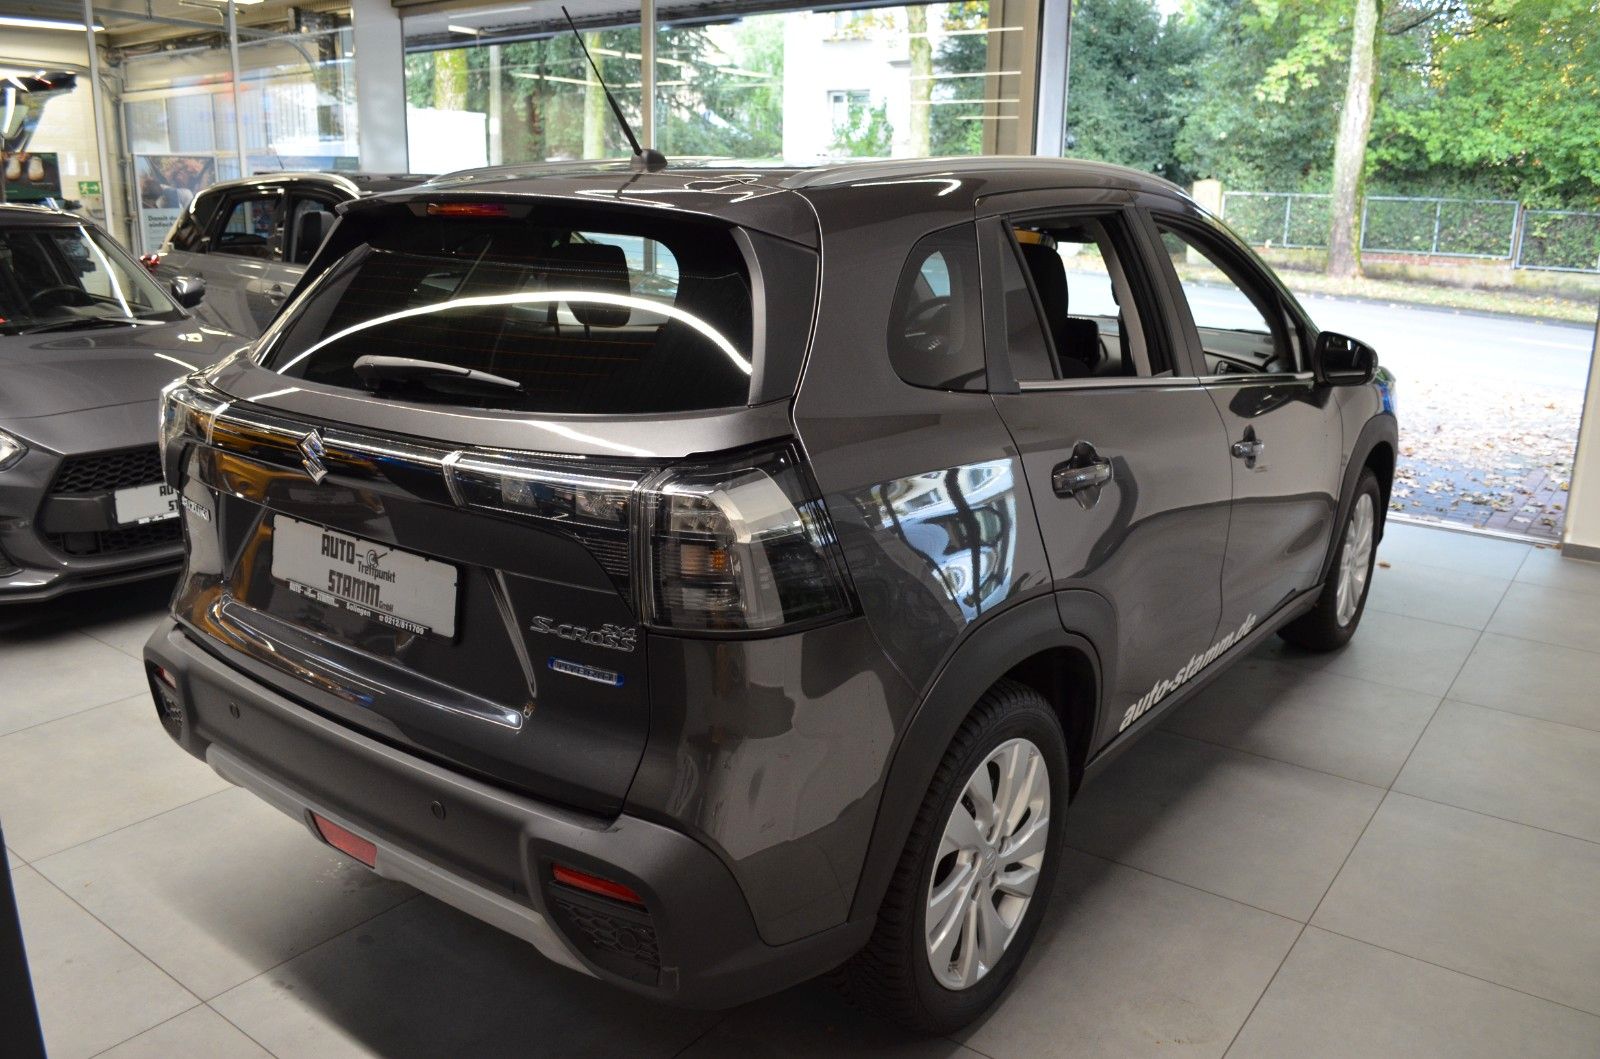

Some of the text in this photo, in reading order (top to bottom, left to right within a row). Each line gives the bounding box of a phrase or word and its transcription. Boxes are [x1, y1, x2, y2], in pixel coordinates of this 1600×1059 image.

[159, 486, 174, 497] AU
[357, 561, 396, 584] Treffpunkt
[328, 569, 380, 607] STAMM
[346, 601, 371, 617] Solingen
[379, 599, 394, 611] GmbH
[529, 615, 637, 652] S-CROSS
[1118, 613, 1257, 732] auto-stamm.de
